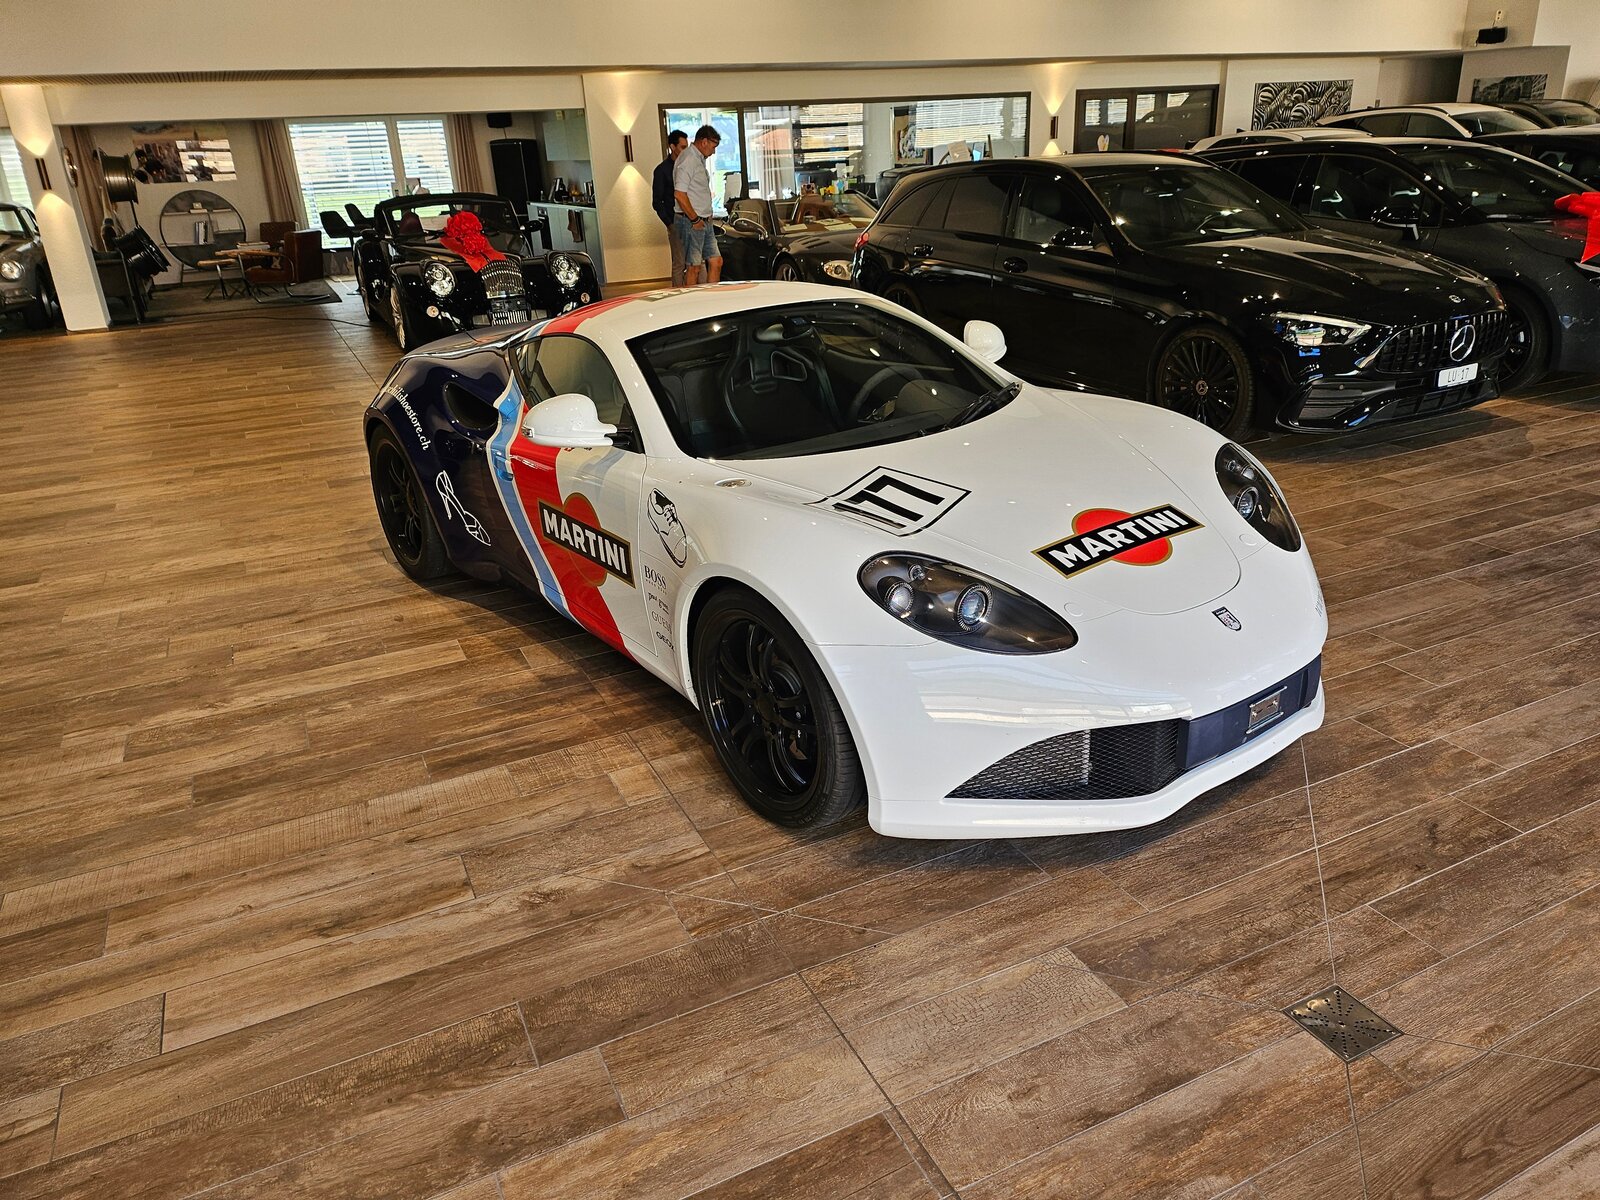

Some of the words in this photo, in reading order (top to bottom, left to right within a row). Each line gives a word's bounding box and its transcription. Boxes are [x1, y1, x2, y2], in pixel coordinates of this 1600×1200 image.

[543, 508, 628, 575] MARTINI
[1048, 509, 1189, 569] MARTINI
[644, 565, 667, 590] BOSS
